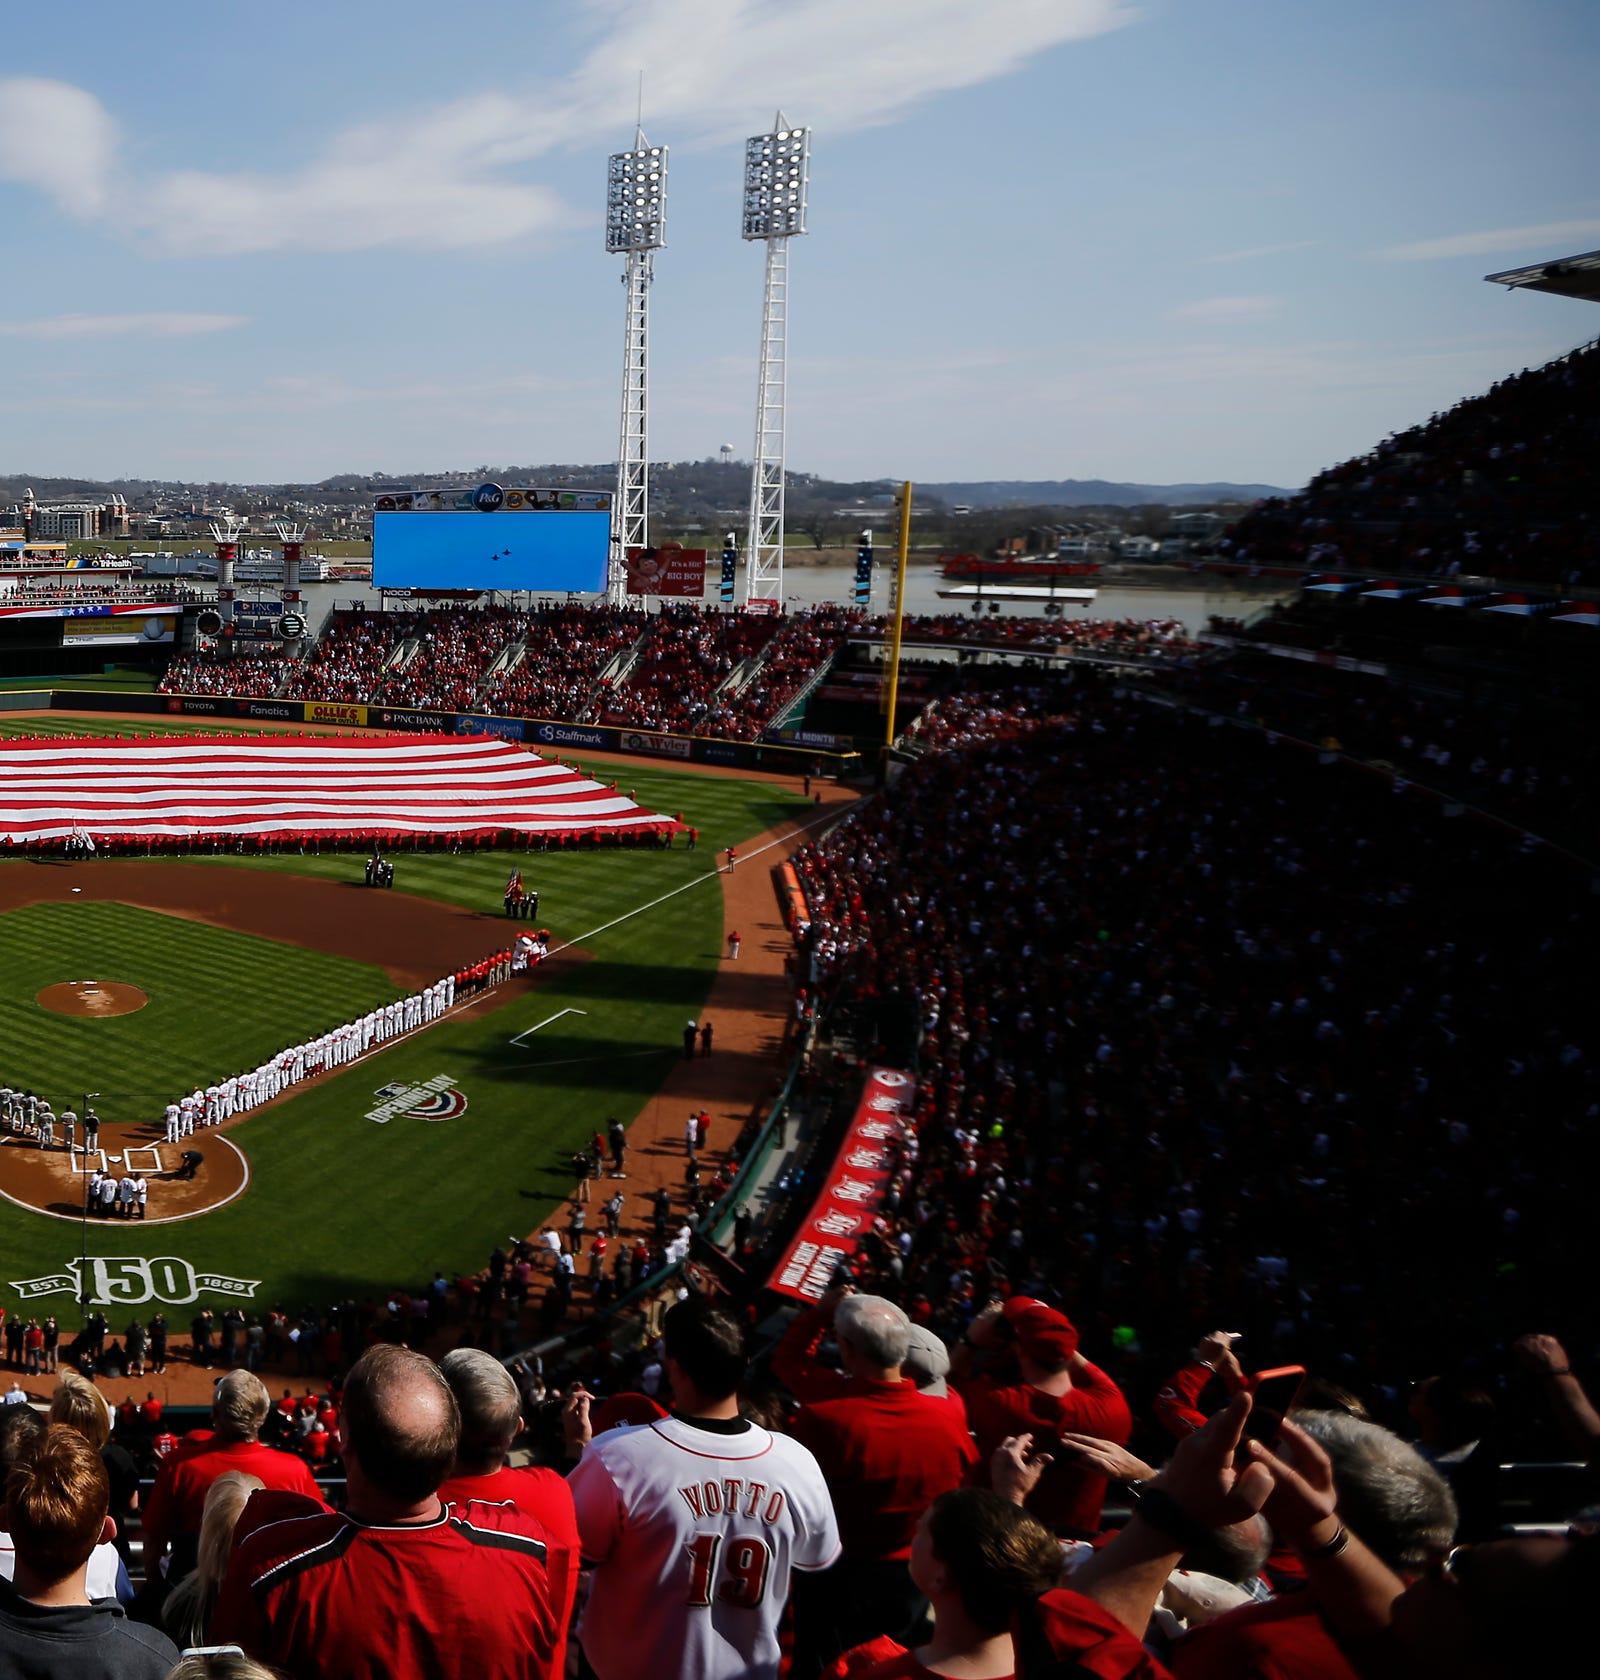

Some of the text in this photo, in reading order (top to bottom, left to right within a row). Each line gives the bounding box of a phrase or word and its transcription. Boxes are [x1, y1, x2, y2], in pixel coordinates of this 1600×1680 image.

[479, 492, 501, 503] P&G
[100, 559, 132, 567] TriHealth
[667, 572, 702, 580] BIG BOY
[251, 603, 274, 611] PNC
[184, 702, 215, 710] TOYOTA
[250, 704, 290, 716] Fanatics
[313, 706, 358, 719] OLLIE'S
[485, 723, 522, 733] Elizabeth
[555, 729, 602, 743] Staffmark
[794, 732, 801, 740] A
[802, 734, 835, 744] MONTH
[364, 1073, 459, 1124] OPENING DAY
[31, 1278, 67, 1292] EST.
[65, 1256, 199, 1305] 150
[202, 1277, 246, 1292] 1869
[679, 1478, 785, 1525] VOTTO
[685, 1531, 772, 1609] 19
